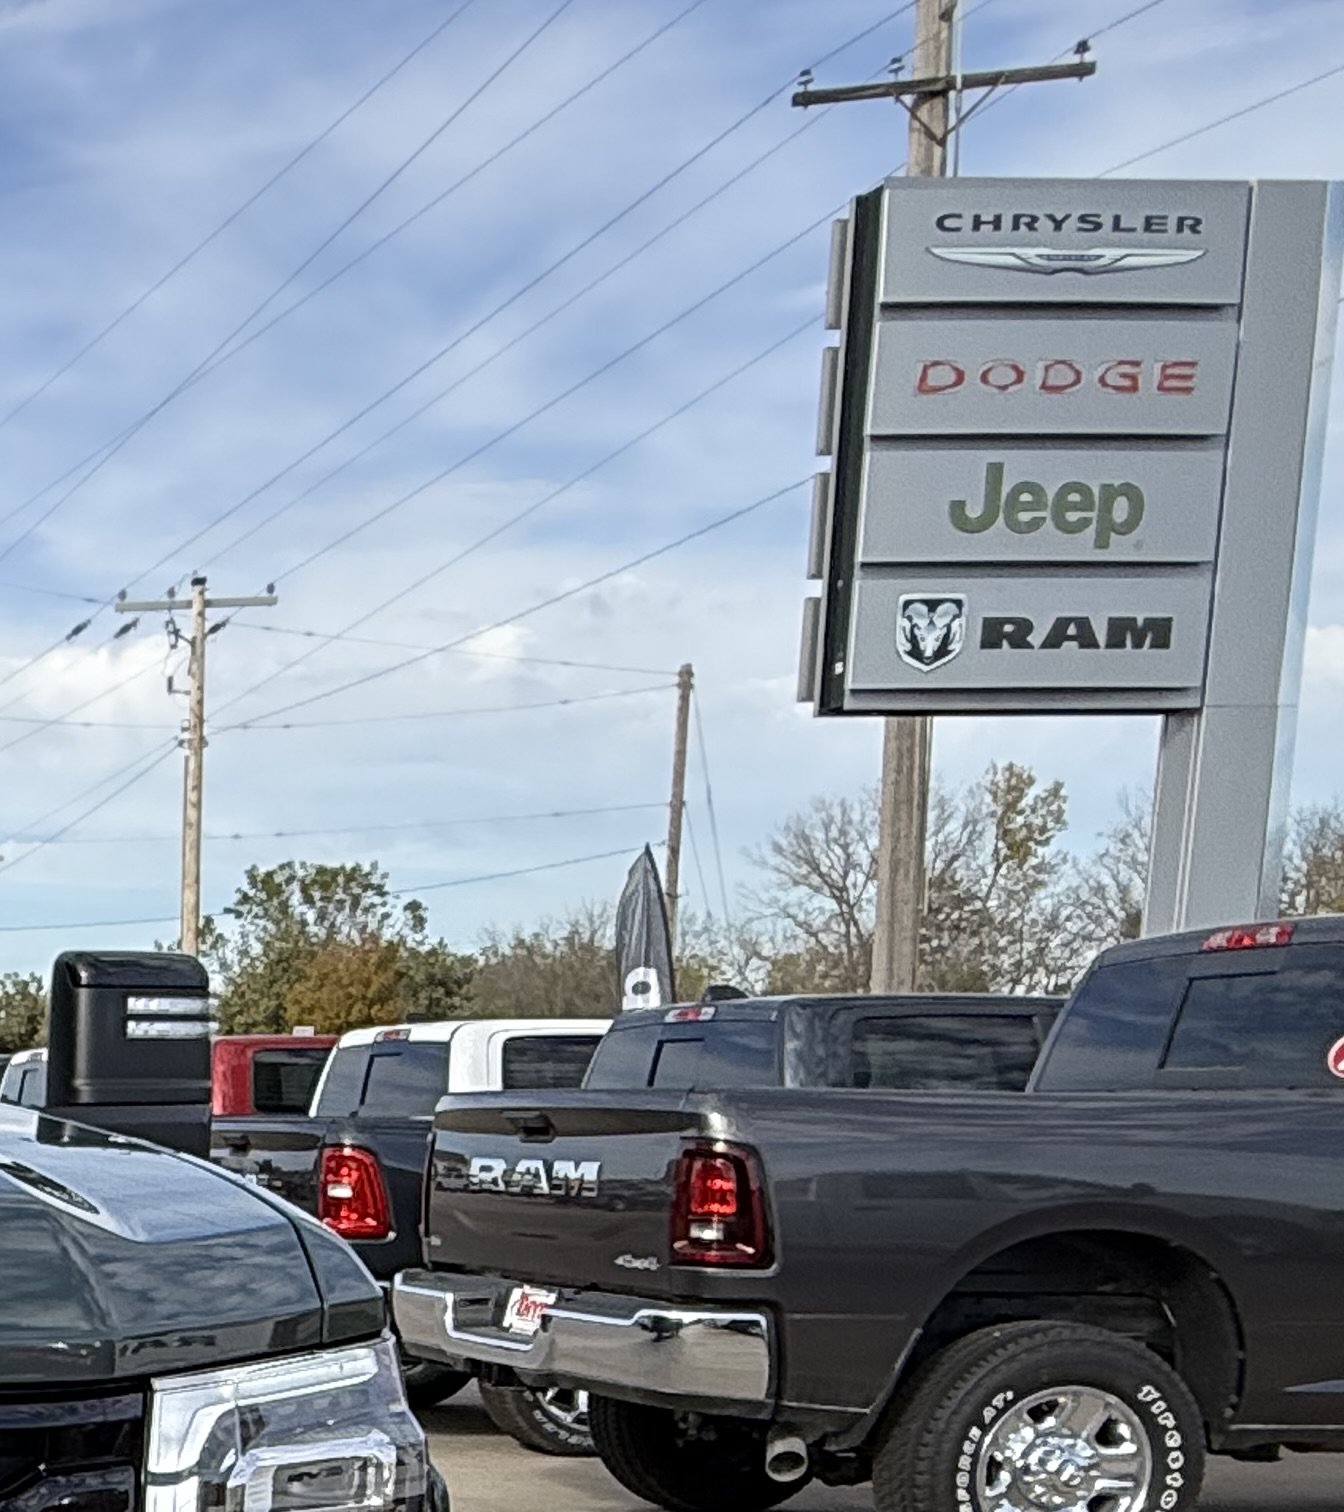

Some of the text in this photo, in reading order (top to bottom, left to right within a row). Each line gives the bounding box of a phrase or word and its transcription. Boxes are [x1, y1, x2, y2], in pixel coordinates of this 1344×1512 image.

[934, 212, 1205, 236] CHRYSLER
[916, 359, 1200, 396] DODGE
[948, 461, 1146, 550] Jeep
[978, 615, 1175, 651] RAM
[468, 1155, 603, 1198] RAM
